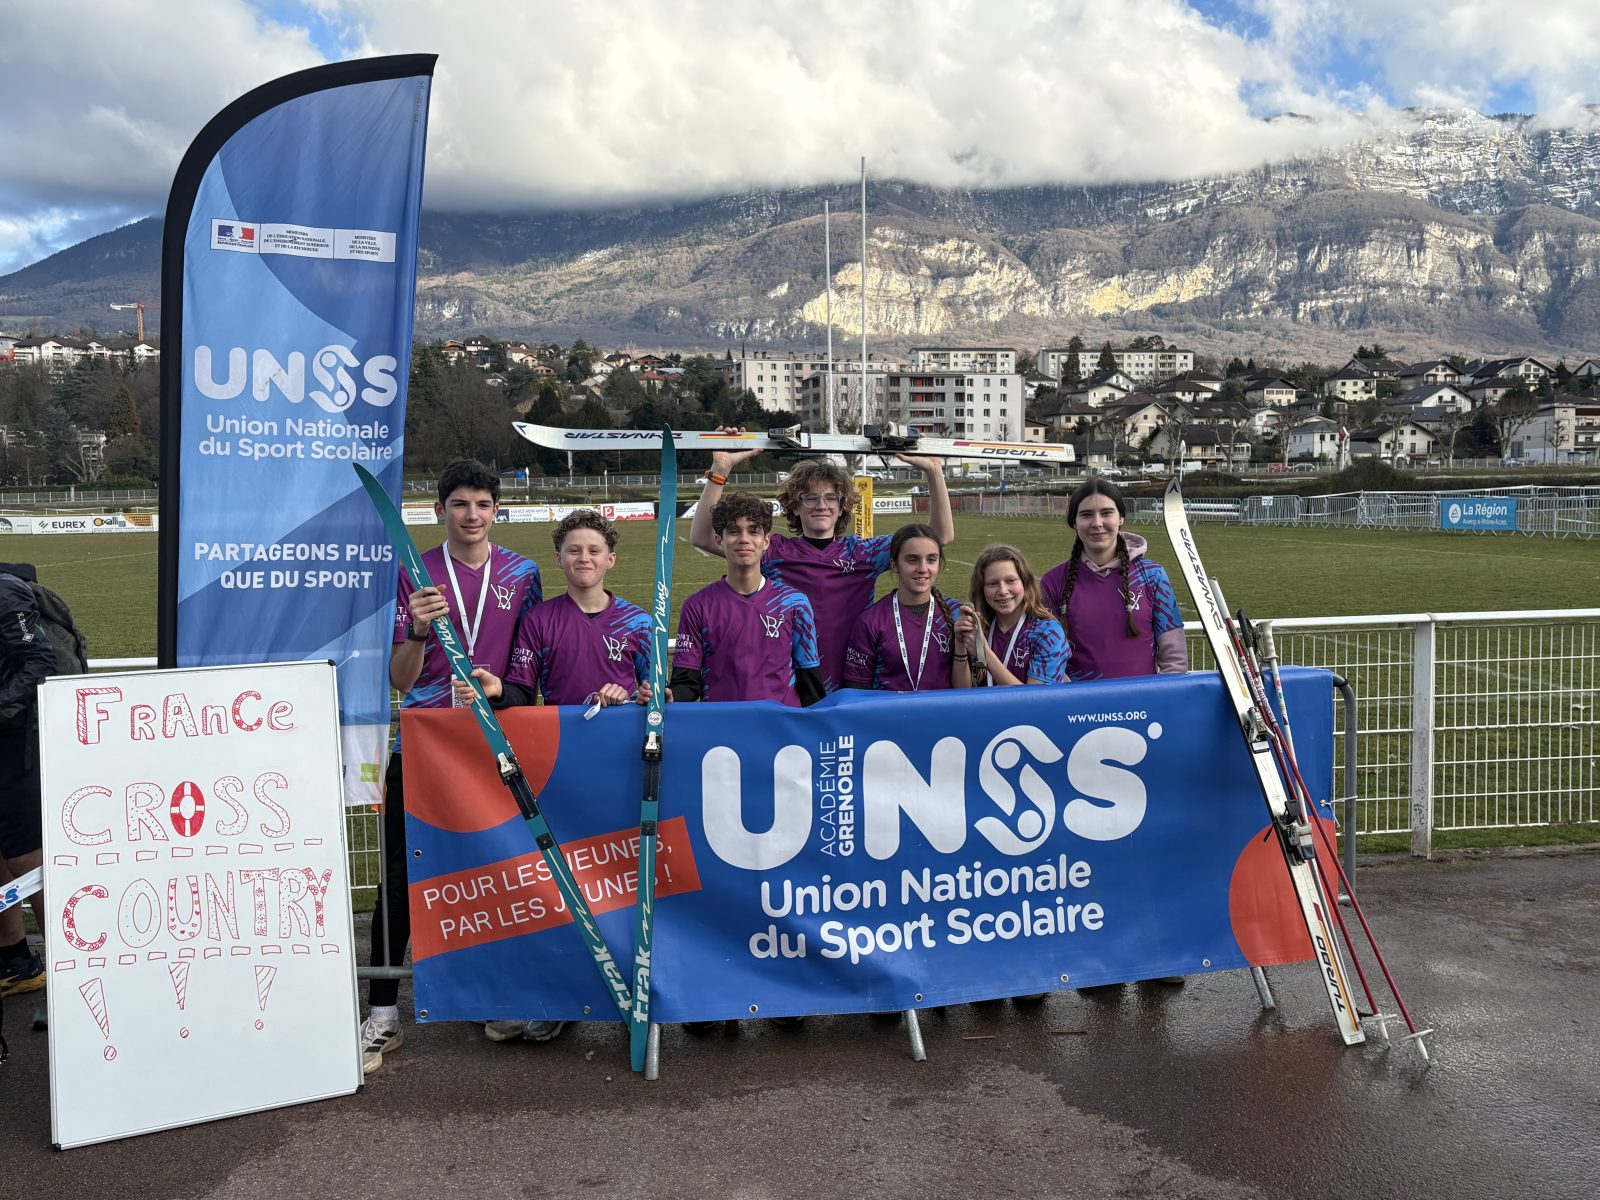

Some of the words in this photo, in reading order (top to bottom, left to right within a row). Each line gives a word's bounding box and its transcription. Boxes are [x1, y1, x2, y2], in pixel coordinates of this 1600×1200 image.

[195, 345, 397, 413] UNSS
[199, 436, 231, 456] du
[238, 438, 304, 461] Sport
[311, 441, 393, 460] Scolaire
[206, 414, 278, 436] Union
[286, 418, 389, 439] Nationale
[981, 447, 1049, 457] TURBO
[1463, 503, 1473, 515] La
[1475, 503, 1507, 518] Région
[194, 543, 340, 562] PARTAGEONS
[346, 544, 393, 562] PLUS
[220, 571, 264, 589] QUE
[270, 570, 299, 588] DU
[304, 571, 373, 589] SPORT
[1180, 528, 1223, 630] DYNASTAR
[1067, 711, 1148, 724] WWW.UNSS.ORG
[61, 771, 292, 847] CROSS
[702, 725, 1147, 870] UNSS
[816, 741, 836, 857] ACADÉMIE
[838, 735, 855, 857] GRENOBLE
[62, 867, 333, 952] COUNTRY
[423, 874, 498, 910] POUR
[502, 859, 553, 892] LES
[440, 911, 493, 940] PAR
[497, 898, 546, 928] LES
[554, 870, 658, 912] JUNE
[761, 874, 887, 919] Union
[901, 853, 1092, 905] Nationale
[749, 924, 807, 959] du
[820, 912, 936, 965] Sport
[947, 896, 1105, 945] Scolaire
[592, 945, 632, 1011] trak
[633, 945, 651, 1024] trak
[1316, 935, 1346, 1012] TURBO
